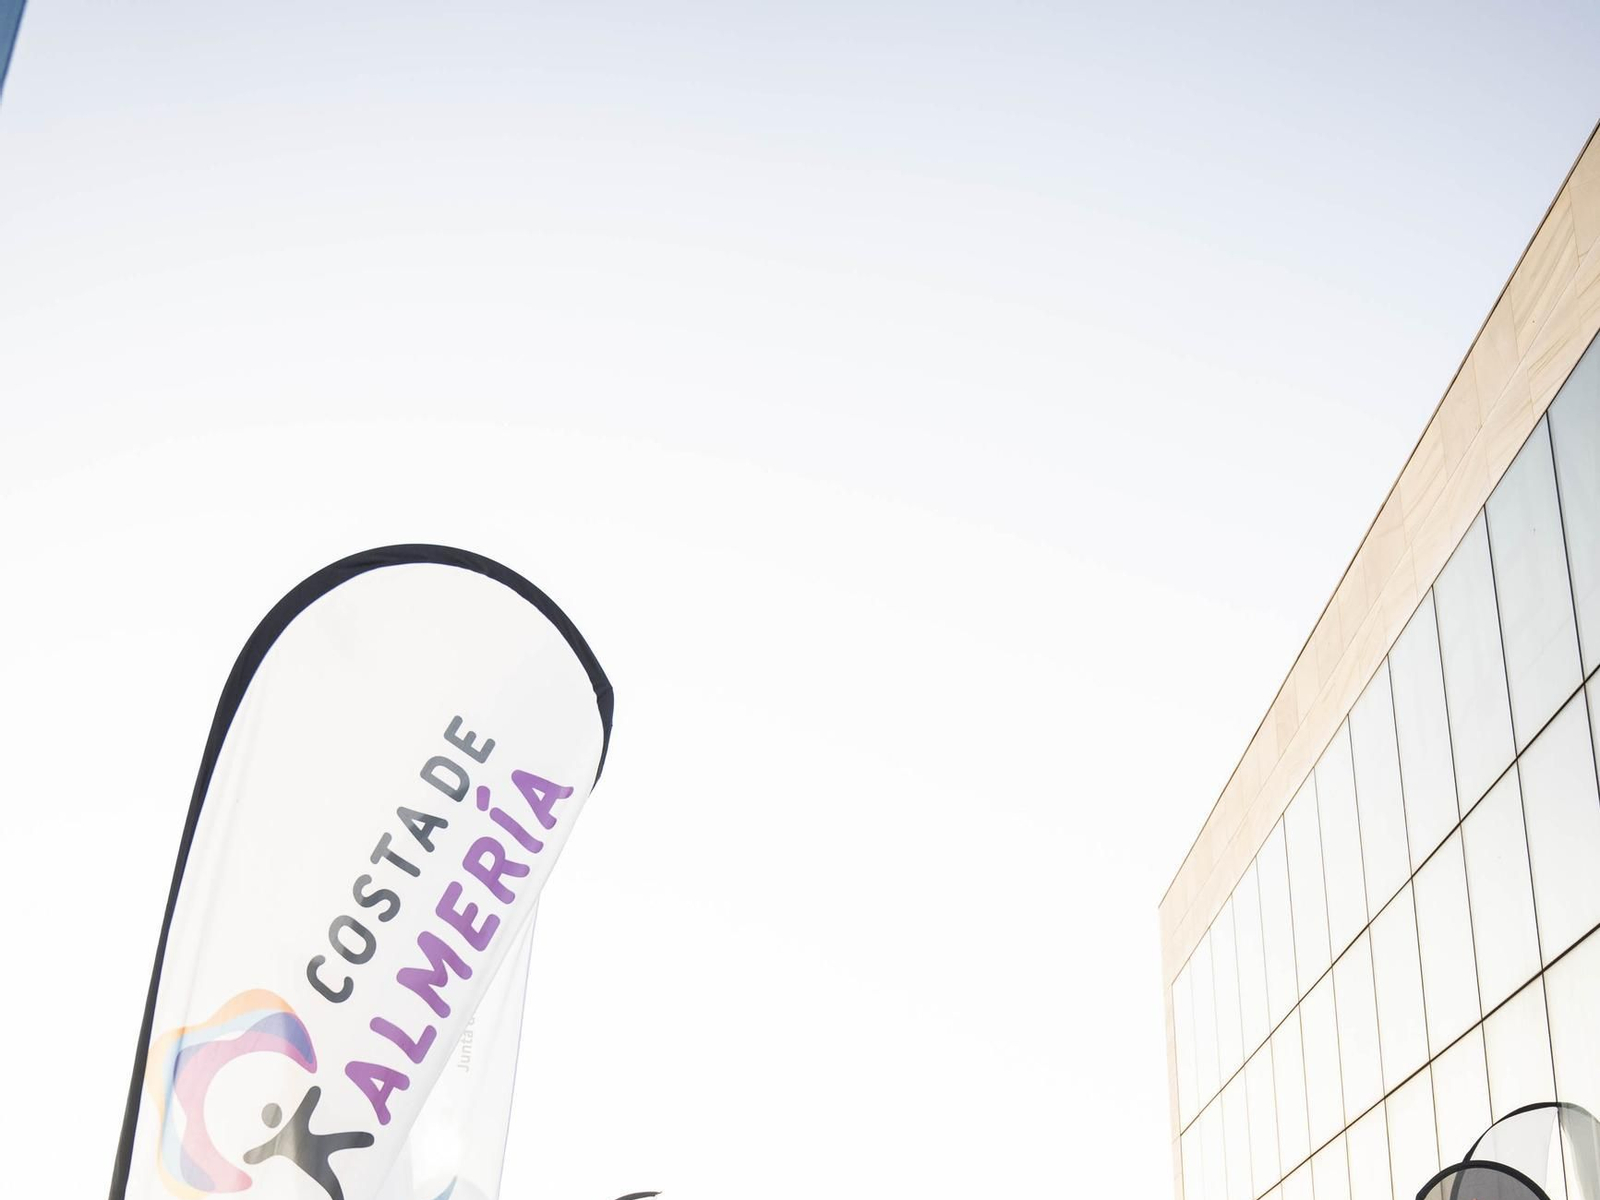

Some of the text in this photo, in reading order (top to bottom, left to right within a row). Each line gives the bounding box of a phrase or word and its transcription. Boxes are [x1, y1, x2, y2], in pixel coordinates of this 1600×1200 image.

[306, 715, 496, 1003] COSTA DE
[344, 769, 574, 1126] ALMERÍA
